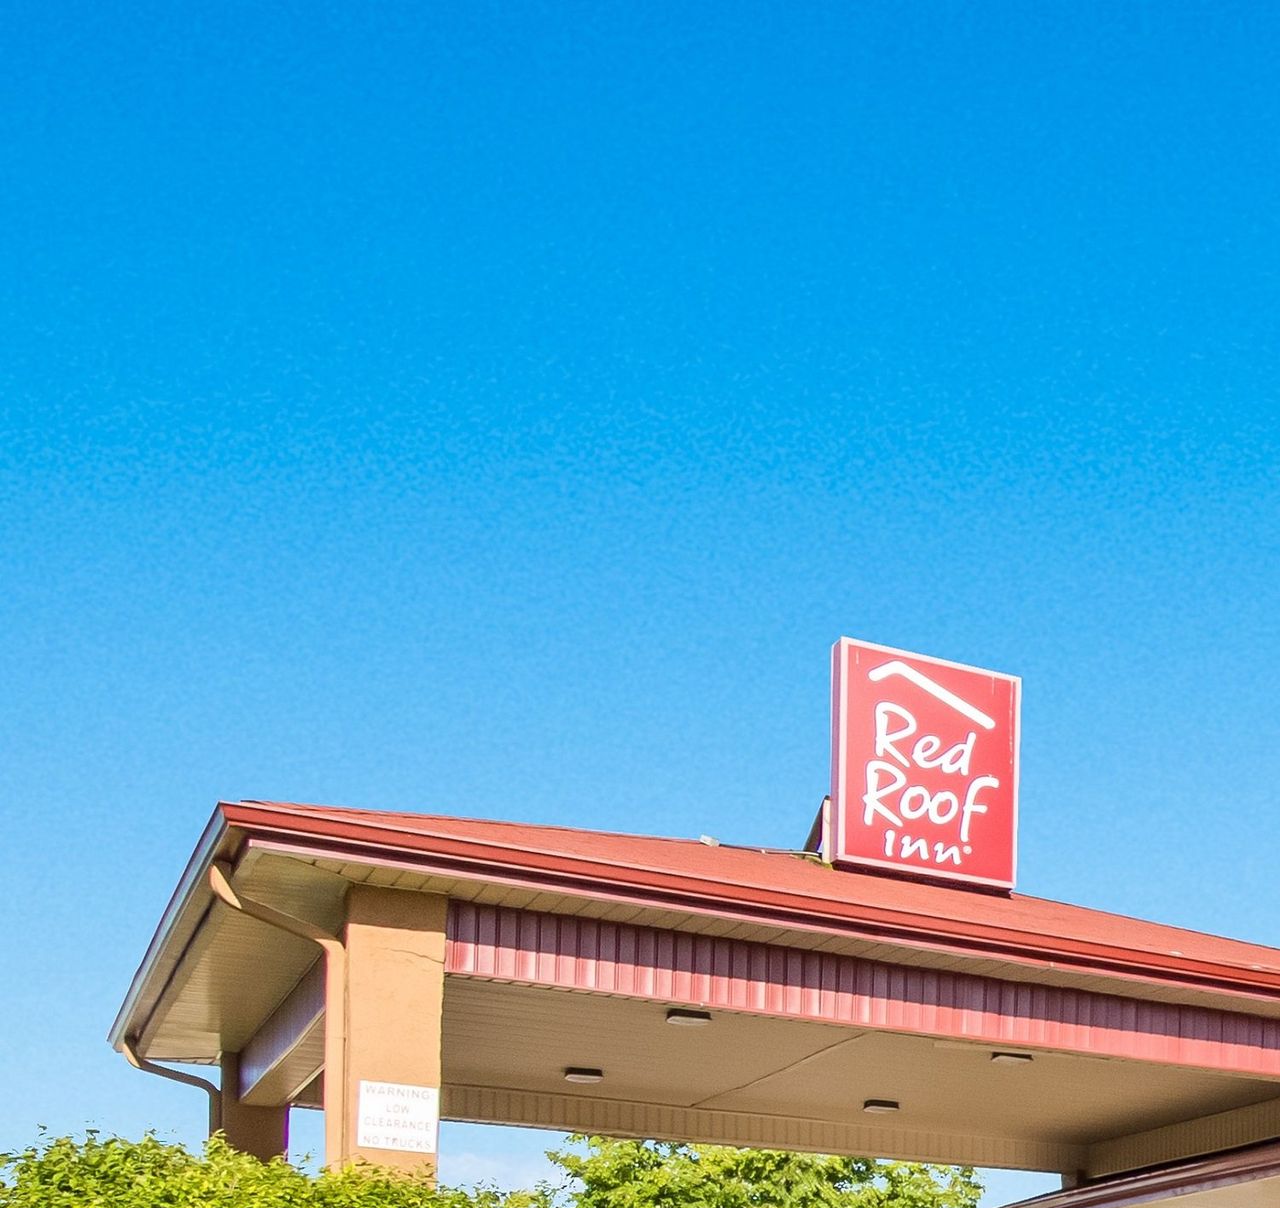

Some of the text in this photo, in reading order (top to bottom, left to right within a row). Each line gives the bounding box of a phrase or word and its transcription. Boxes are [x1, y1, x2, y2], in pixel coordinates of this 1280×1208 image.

[874, 701, 977, 776] Red
[862, 760, 1000, 842] Roof
[385, 1103, 410, 1114] LOW
[363, 1115, 432, 1132] CLEARANCE
[362, 1135, 432, 1151] NO TRUCKS
